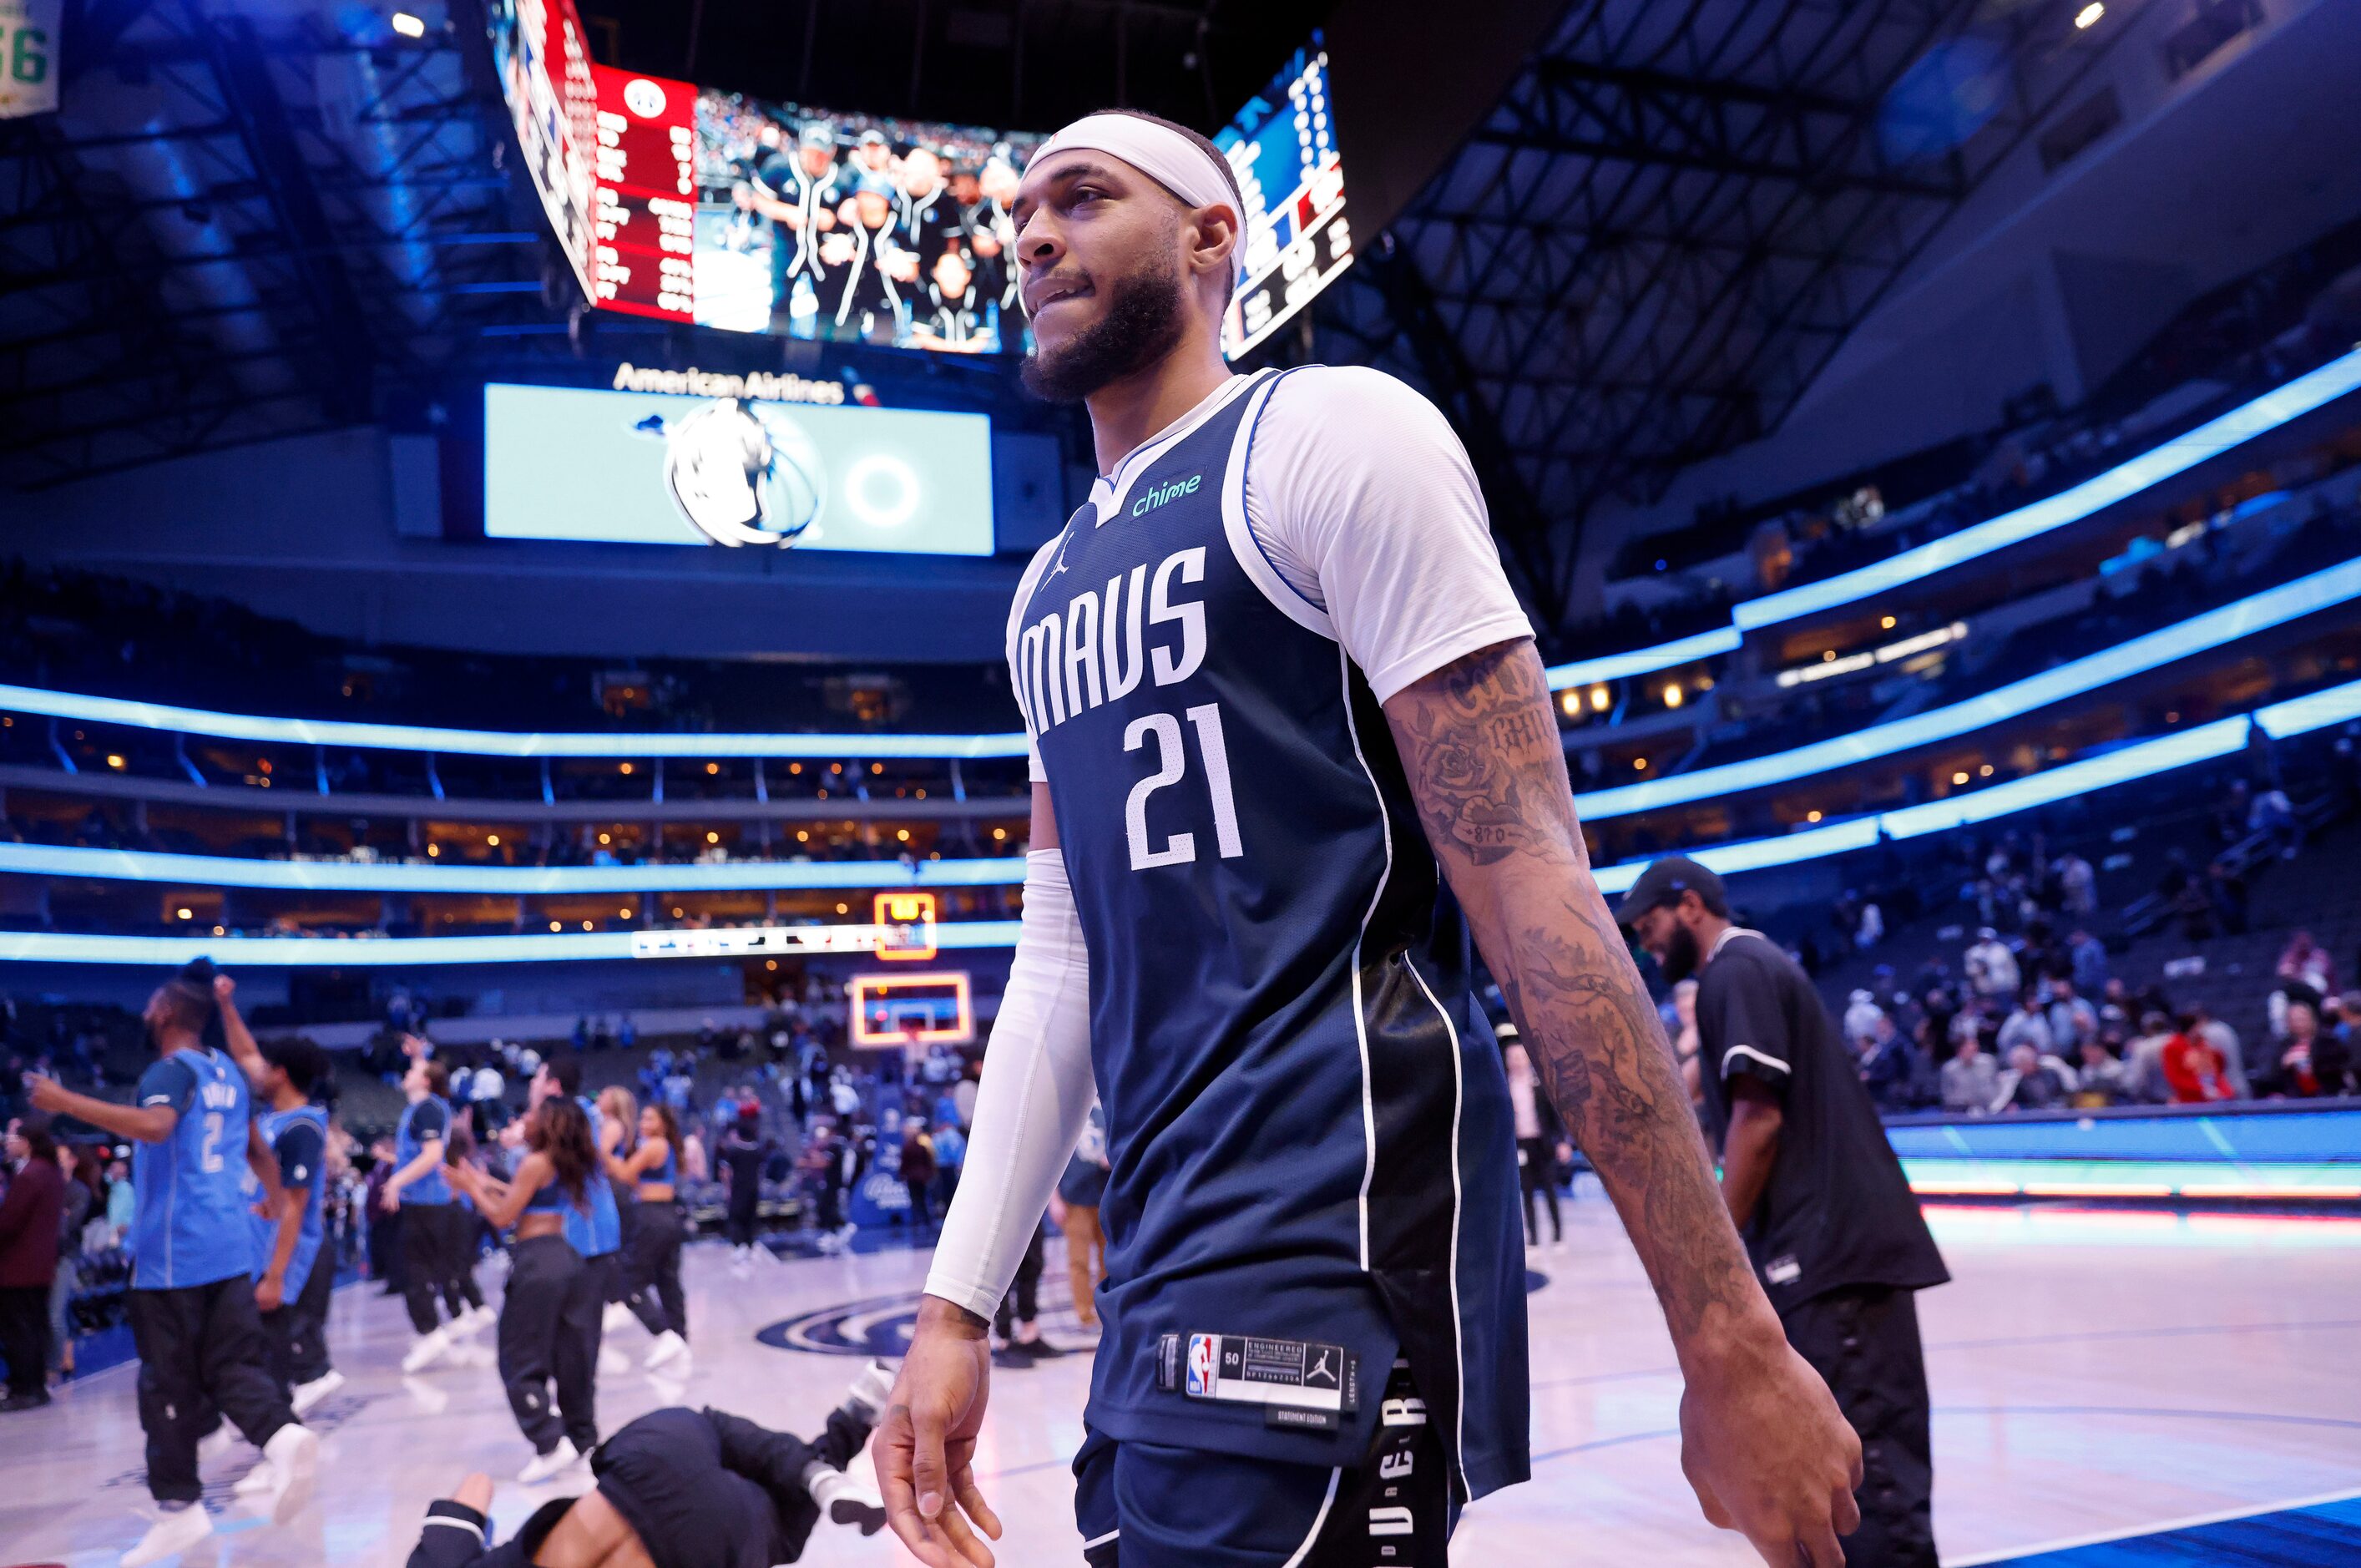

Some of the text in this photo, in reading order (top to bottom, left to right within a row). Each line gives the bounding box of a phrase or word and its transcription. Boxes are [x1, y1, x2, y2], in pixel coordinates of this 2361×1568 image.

[0, 28, 47, 83] 6
[613, 362, 845, 405] American Airlines
[1132, 474, 1201, 518] chime
[1123, 702, 1244, 872] 21
[202, 1112, 225, 1173] 2
[1225, 1352, 1240, 1365] 50
[1277, 1411, 1327, 1424] STATEMENT EDITION
